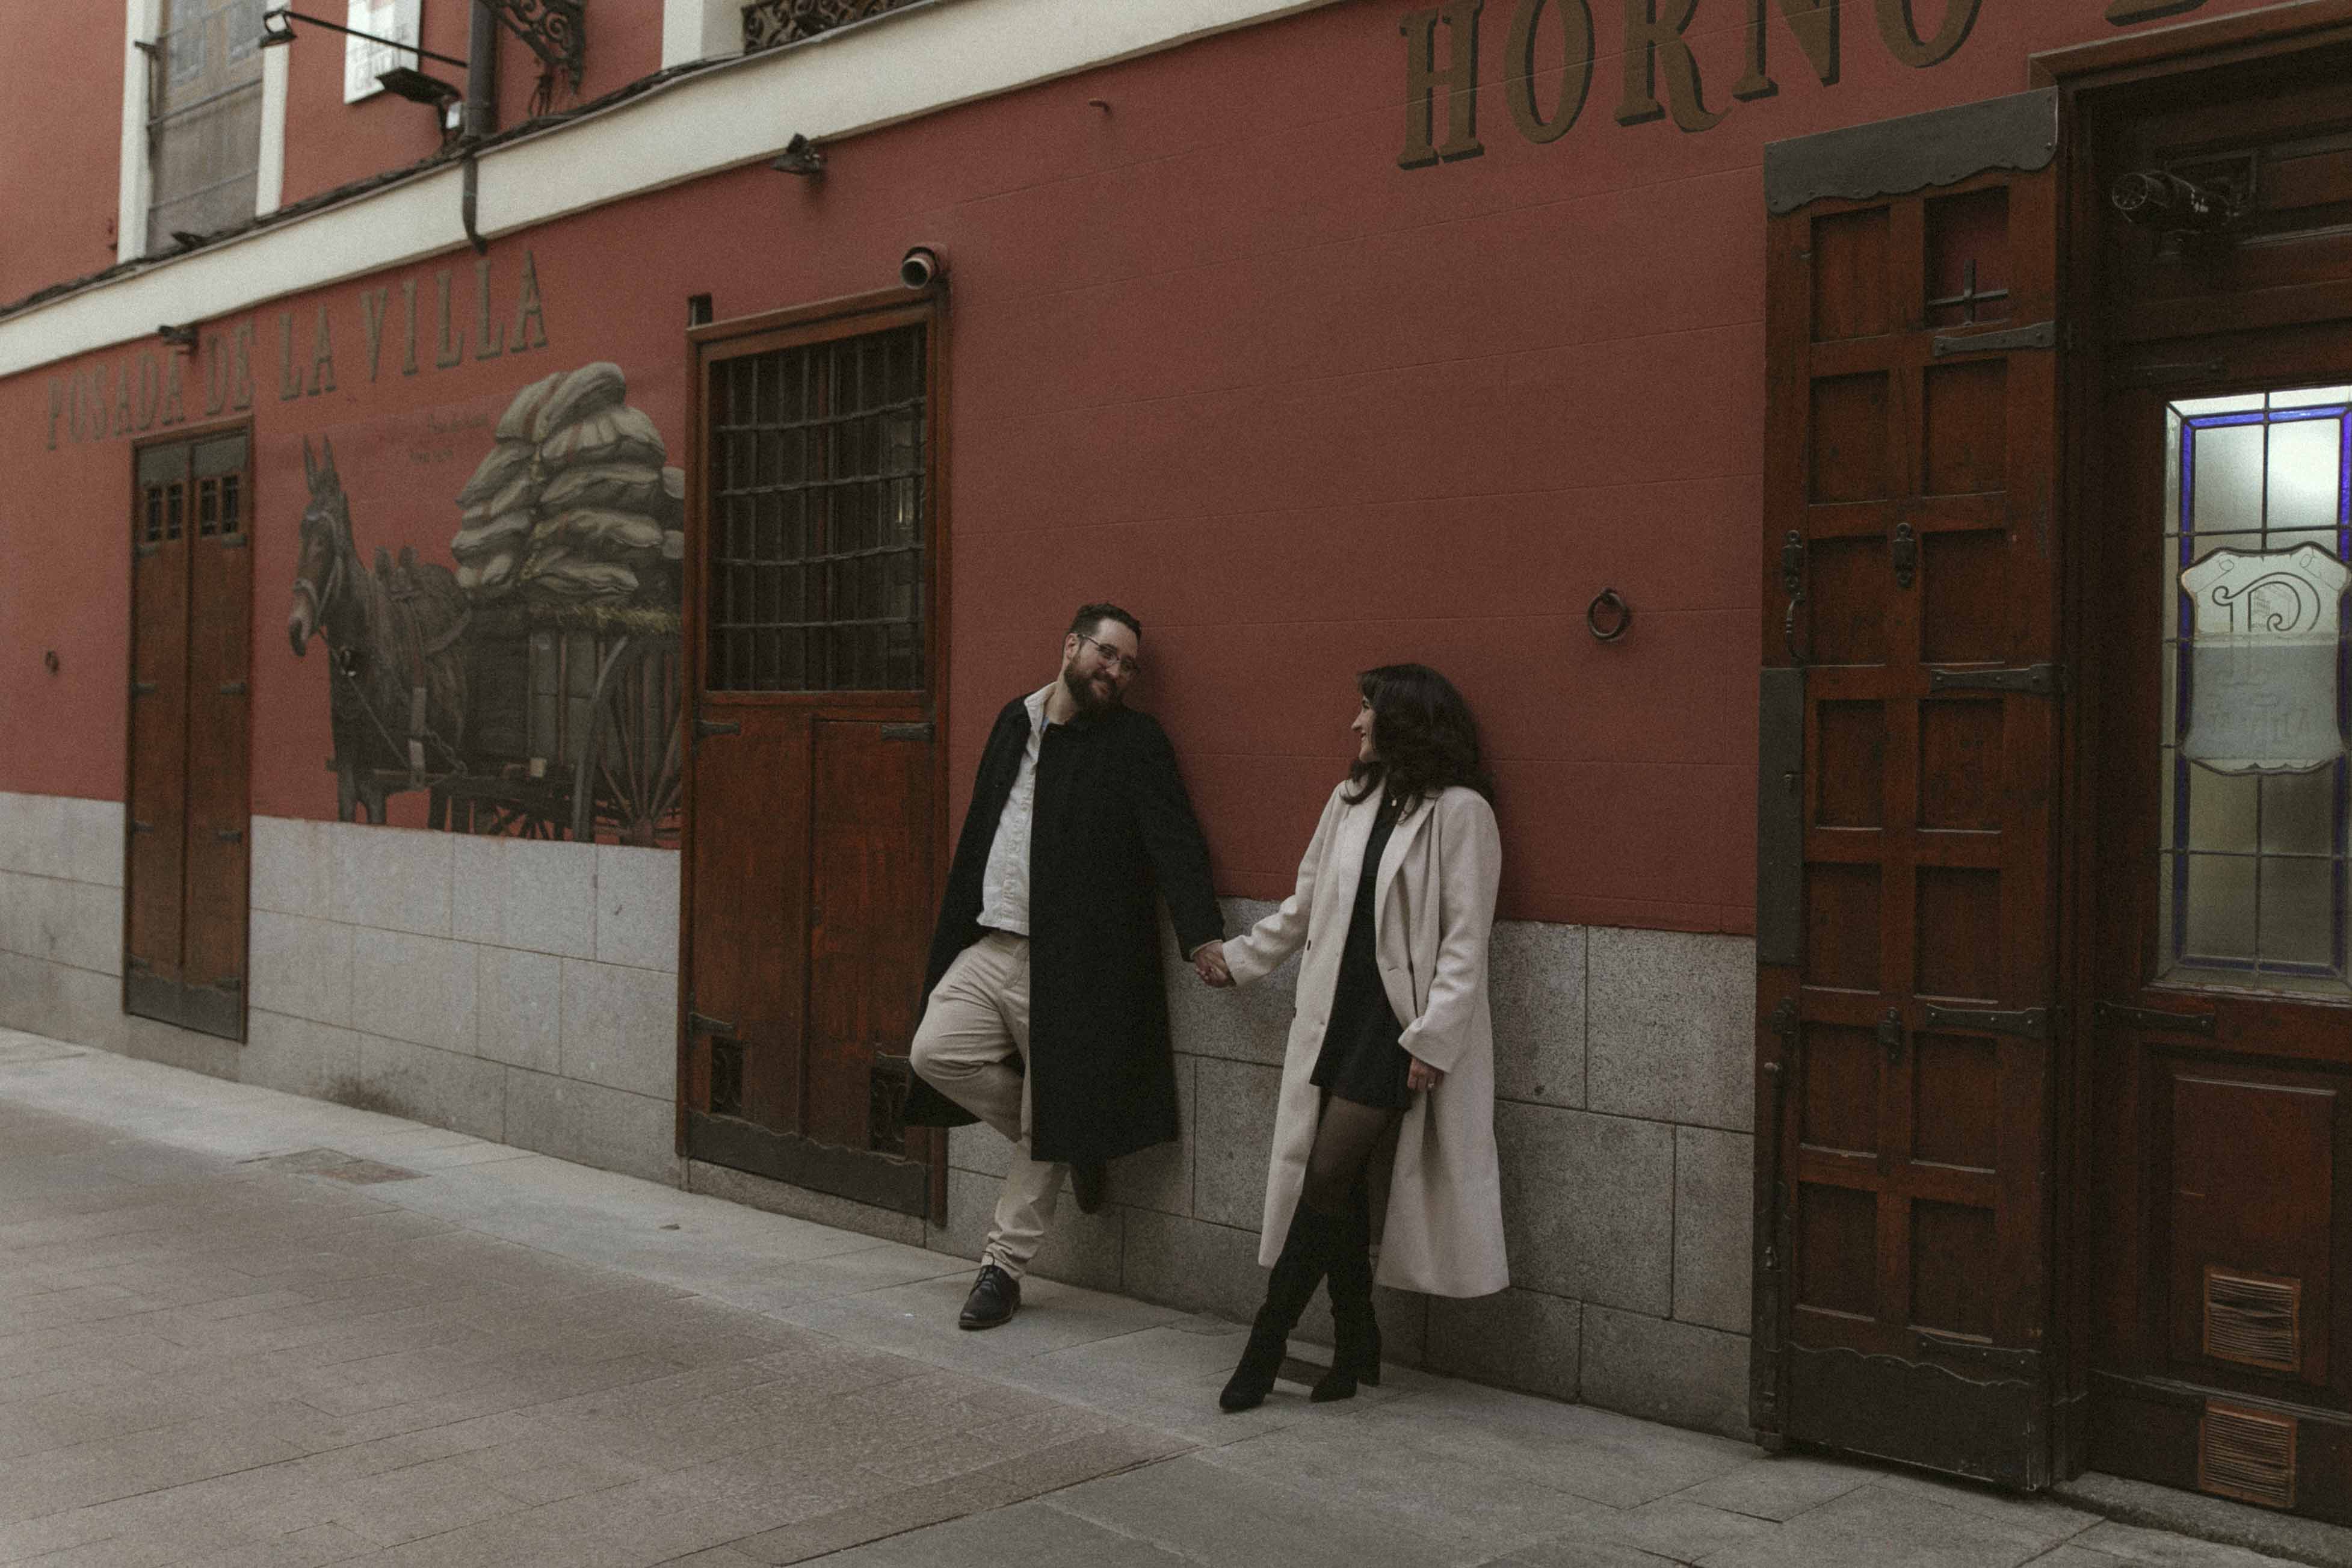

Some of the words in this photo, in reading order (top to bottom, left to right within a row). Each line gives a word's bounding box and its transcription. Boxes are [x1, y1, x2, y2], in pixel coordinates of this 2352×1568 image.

[45, 345, 185, 451] POSADA
[203, 317, 256, 416] DE
[279, 304, 337, 401] LA
[360, 249, 548, 384] VILLA
